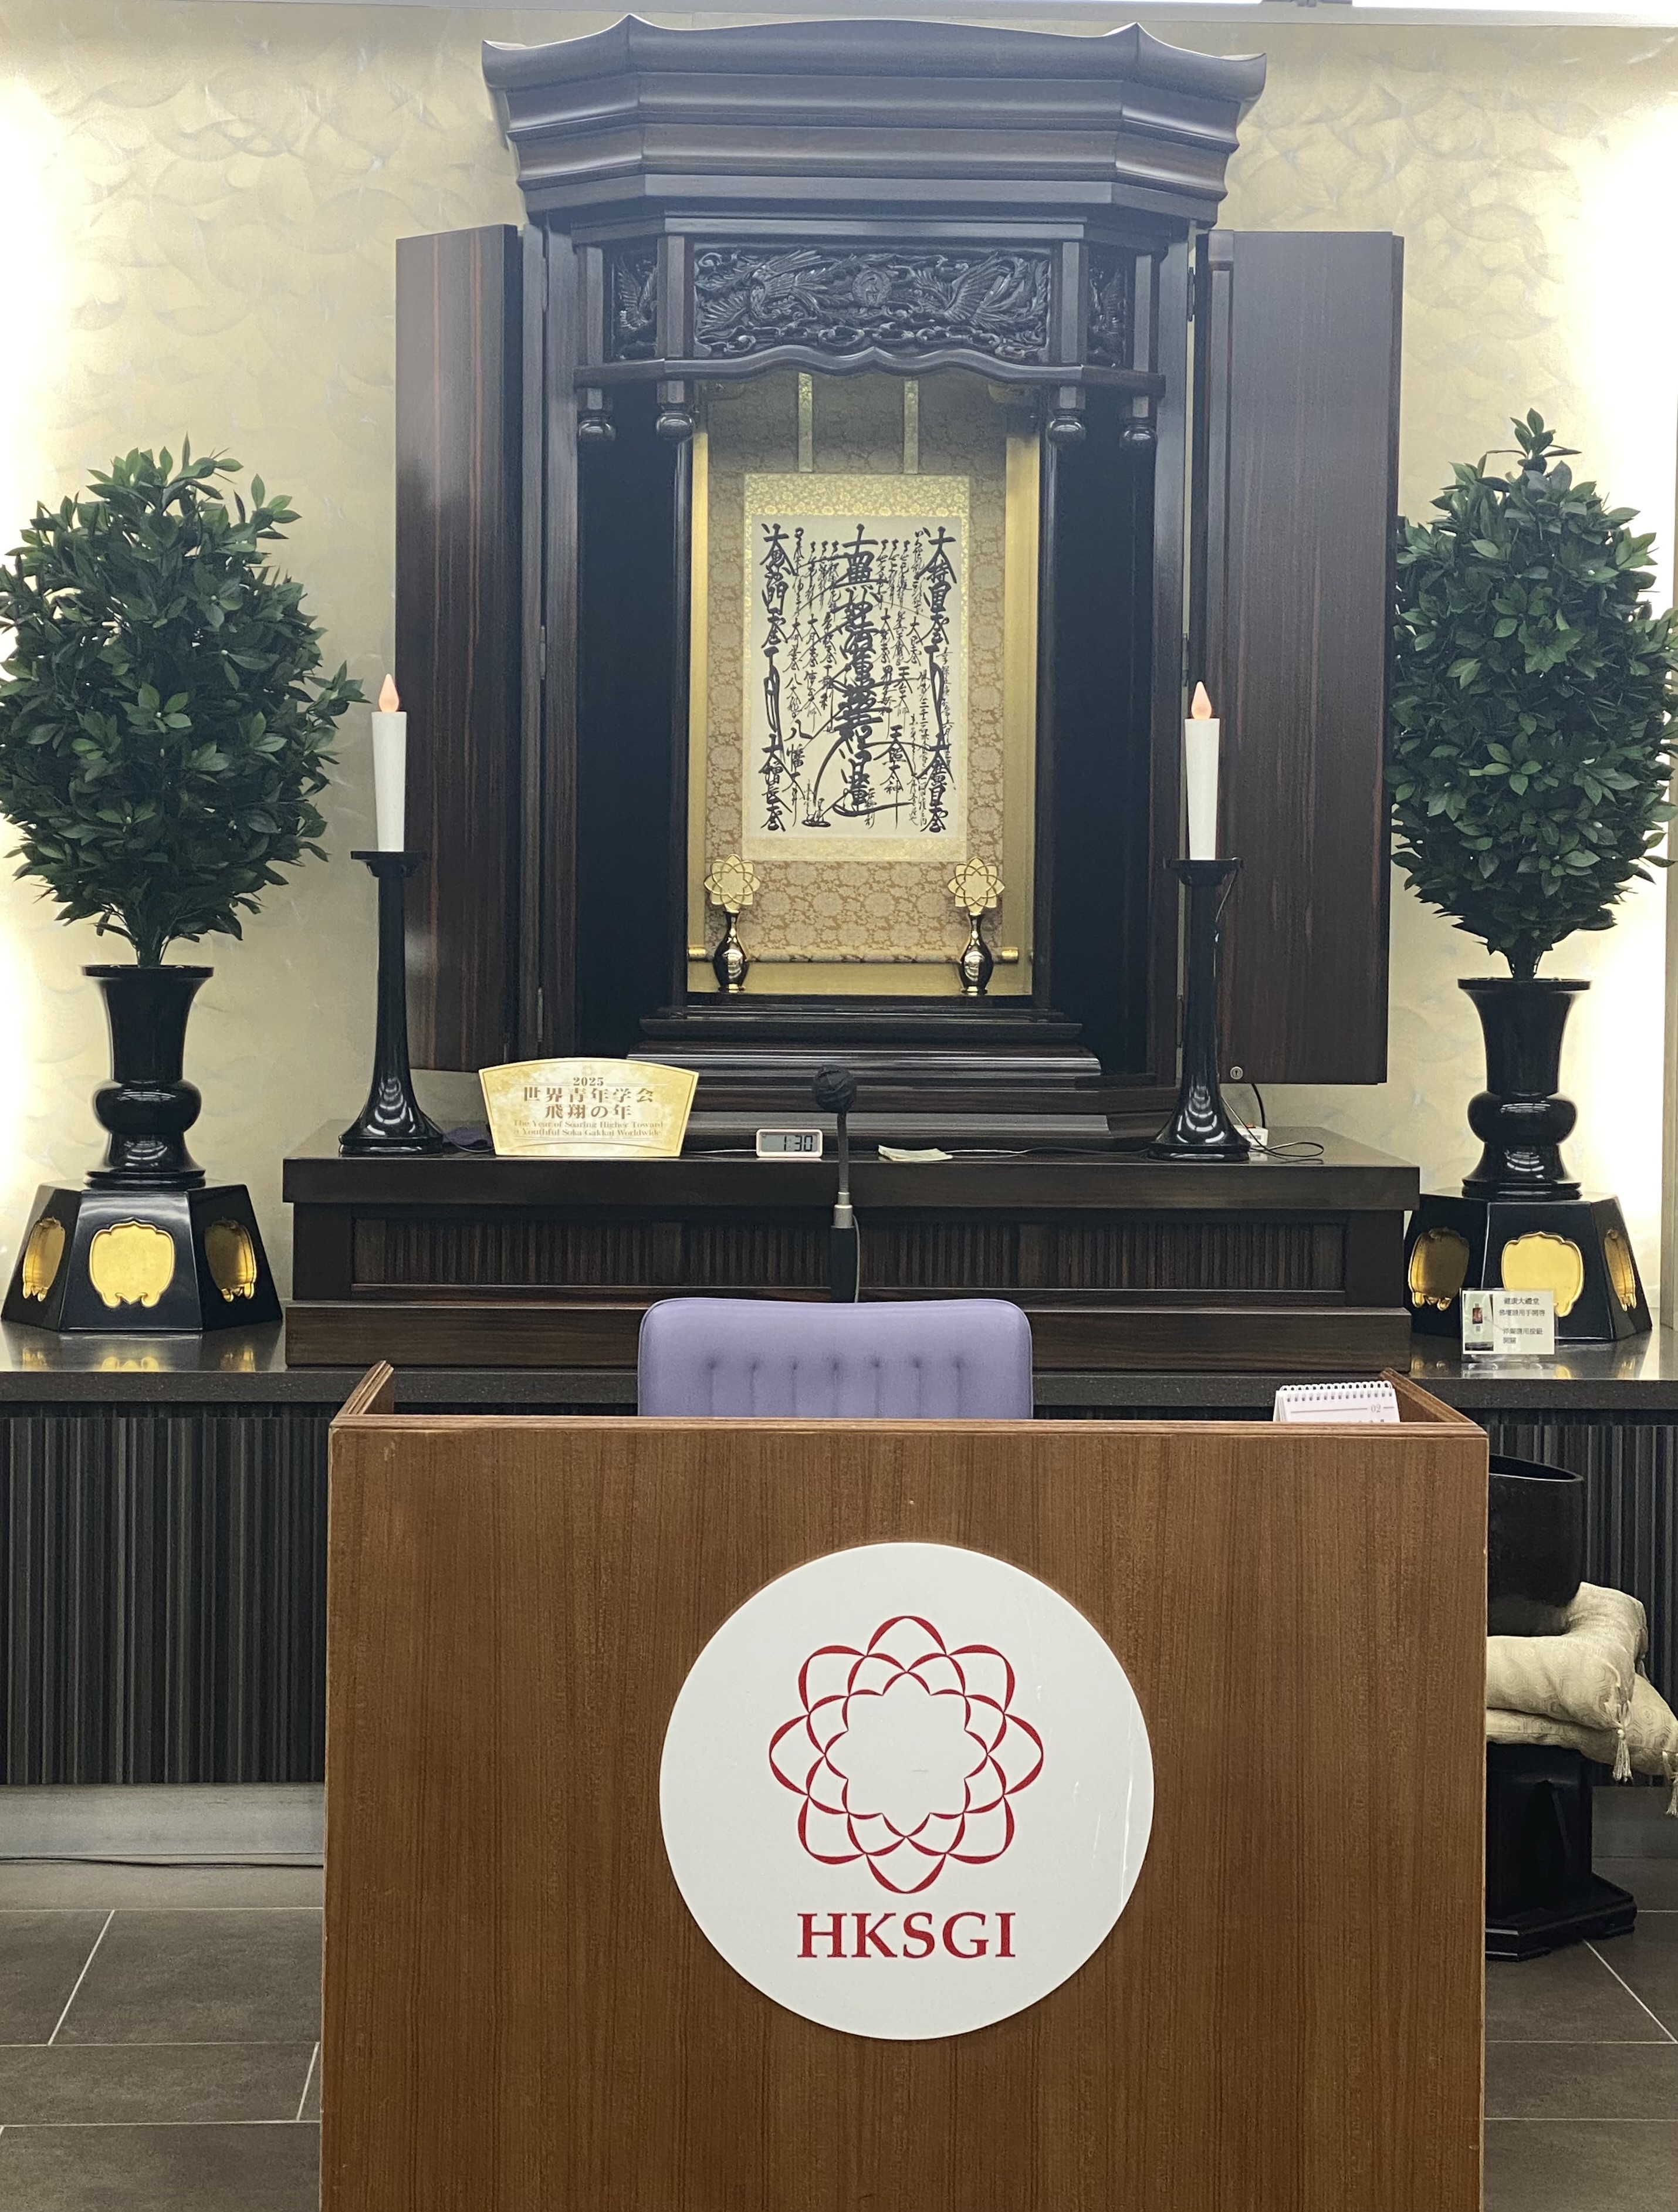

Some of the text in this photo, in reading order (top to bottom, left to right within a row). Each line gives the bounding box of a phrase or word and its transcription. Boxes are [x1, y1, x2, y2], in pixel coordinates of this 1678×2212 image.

[573, 1077, 604, 1086] 2025
[524, 1087, 654, 1103] 世界青年学会
[544, 1104, 632, 1119] 飛翔の年
[564, 1121, 597, 1129] Soaring
[600, 1121, 628, 1129] Higher
[562, 1128, 582, 1136] Soka
[584, 1129, 615, 1137] Gakkai
[1371, 1403, 1381, 1413] 02
[797, 1912, 1016, 1959] HKSGI
